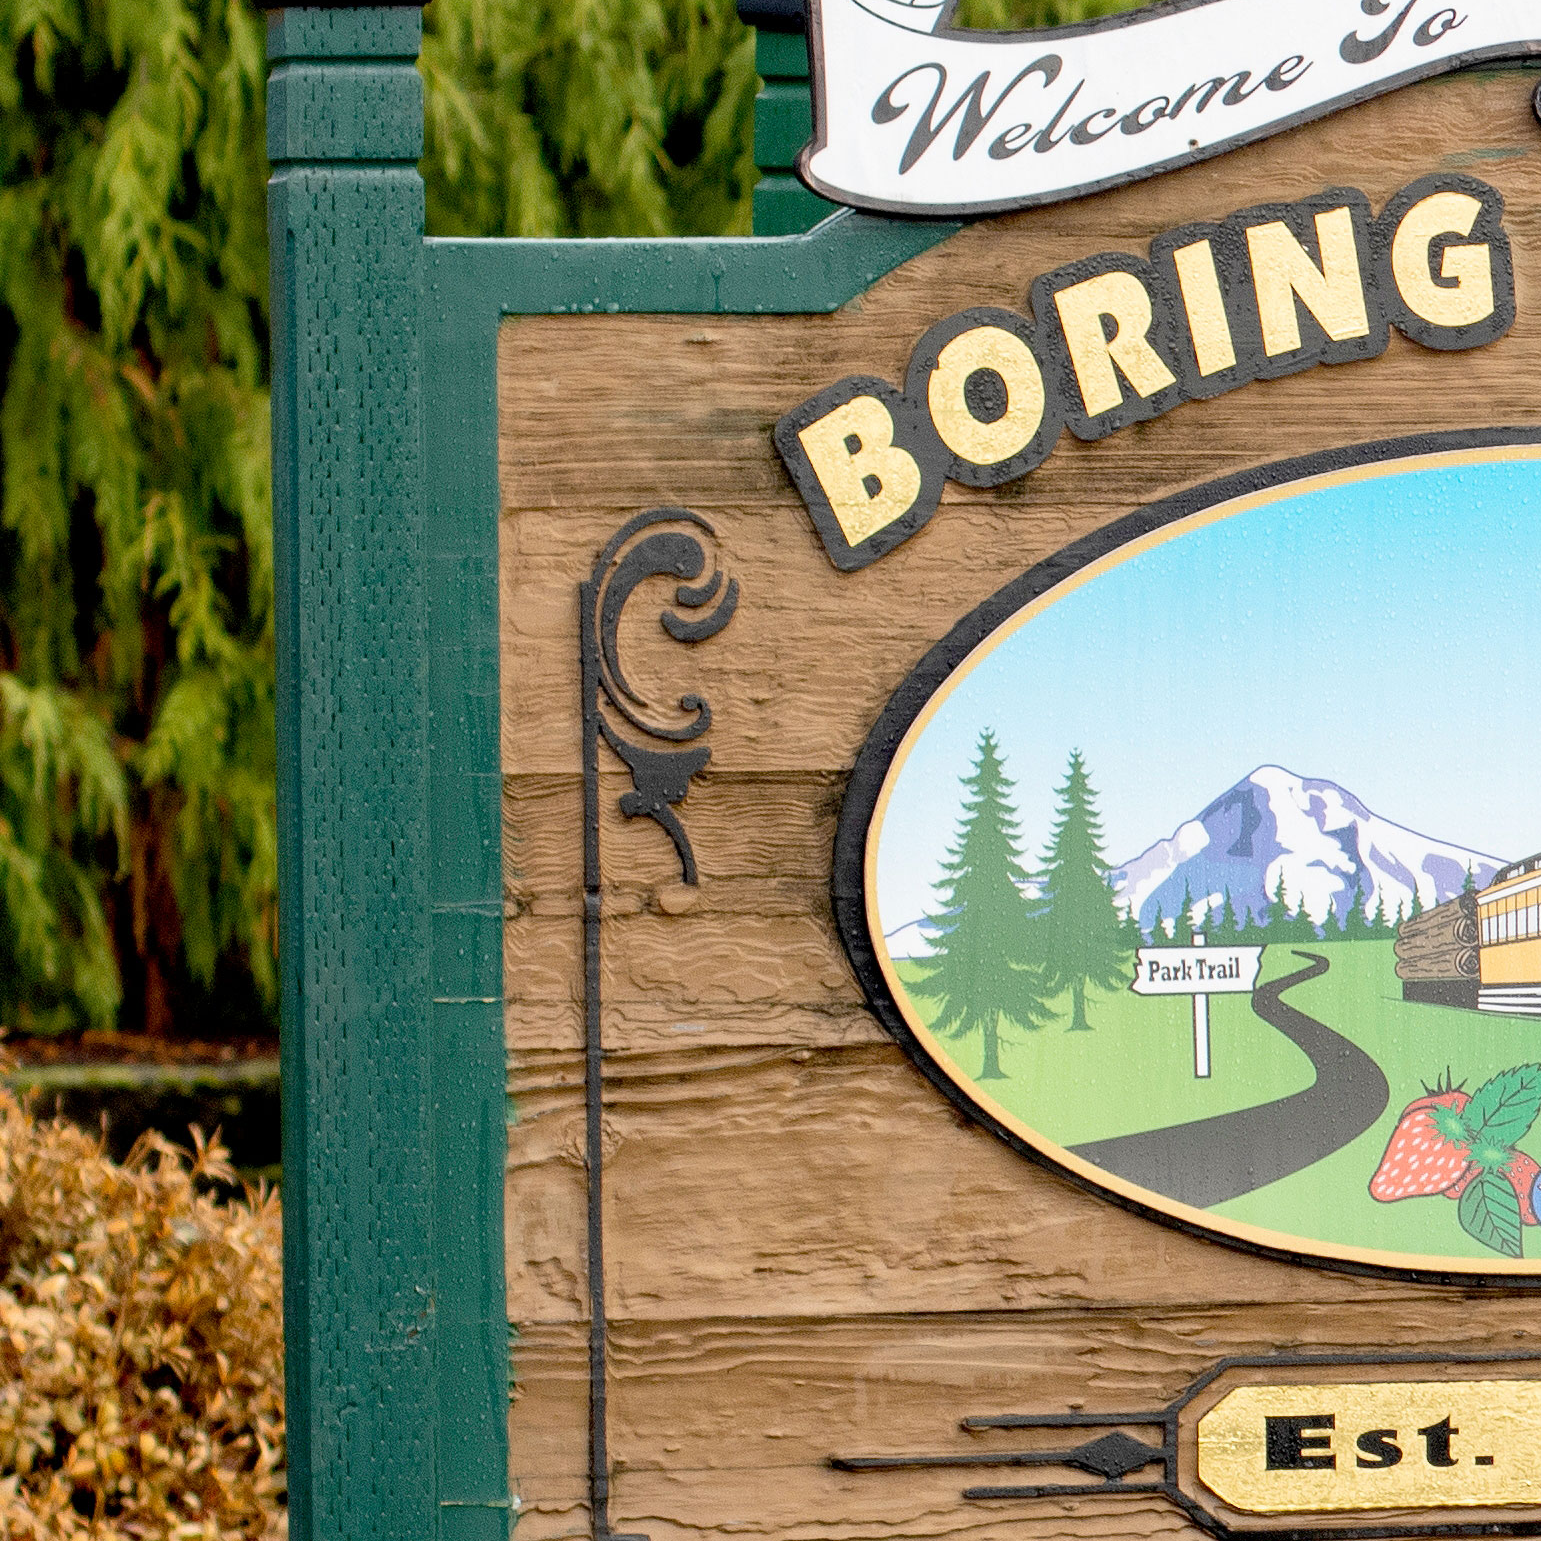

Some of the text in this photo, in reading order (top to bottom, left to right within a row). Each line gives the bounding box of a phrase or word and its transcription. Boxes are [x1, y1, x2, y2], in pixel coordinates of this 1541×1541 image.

[870, 45, 1309, 178] Welcome
[797, 190, 1500, 551] BORING
[1147, 956, 1241, 982] Park Trail
[1264, 1412, 1495, 1471] Est.
